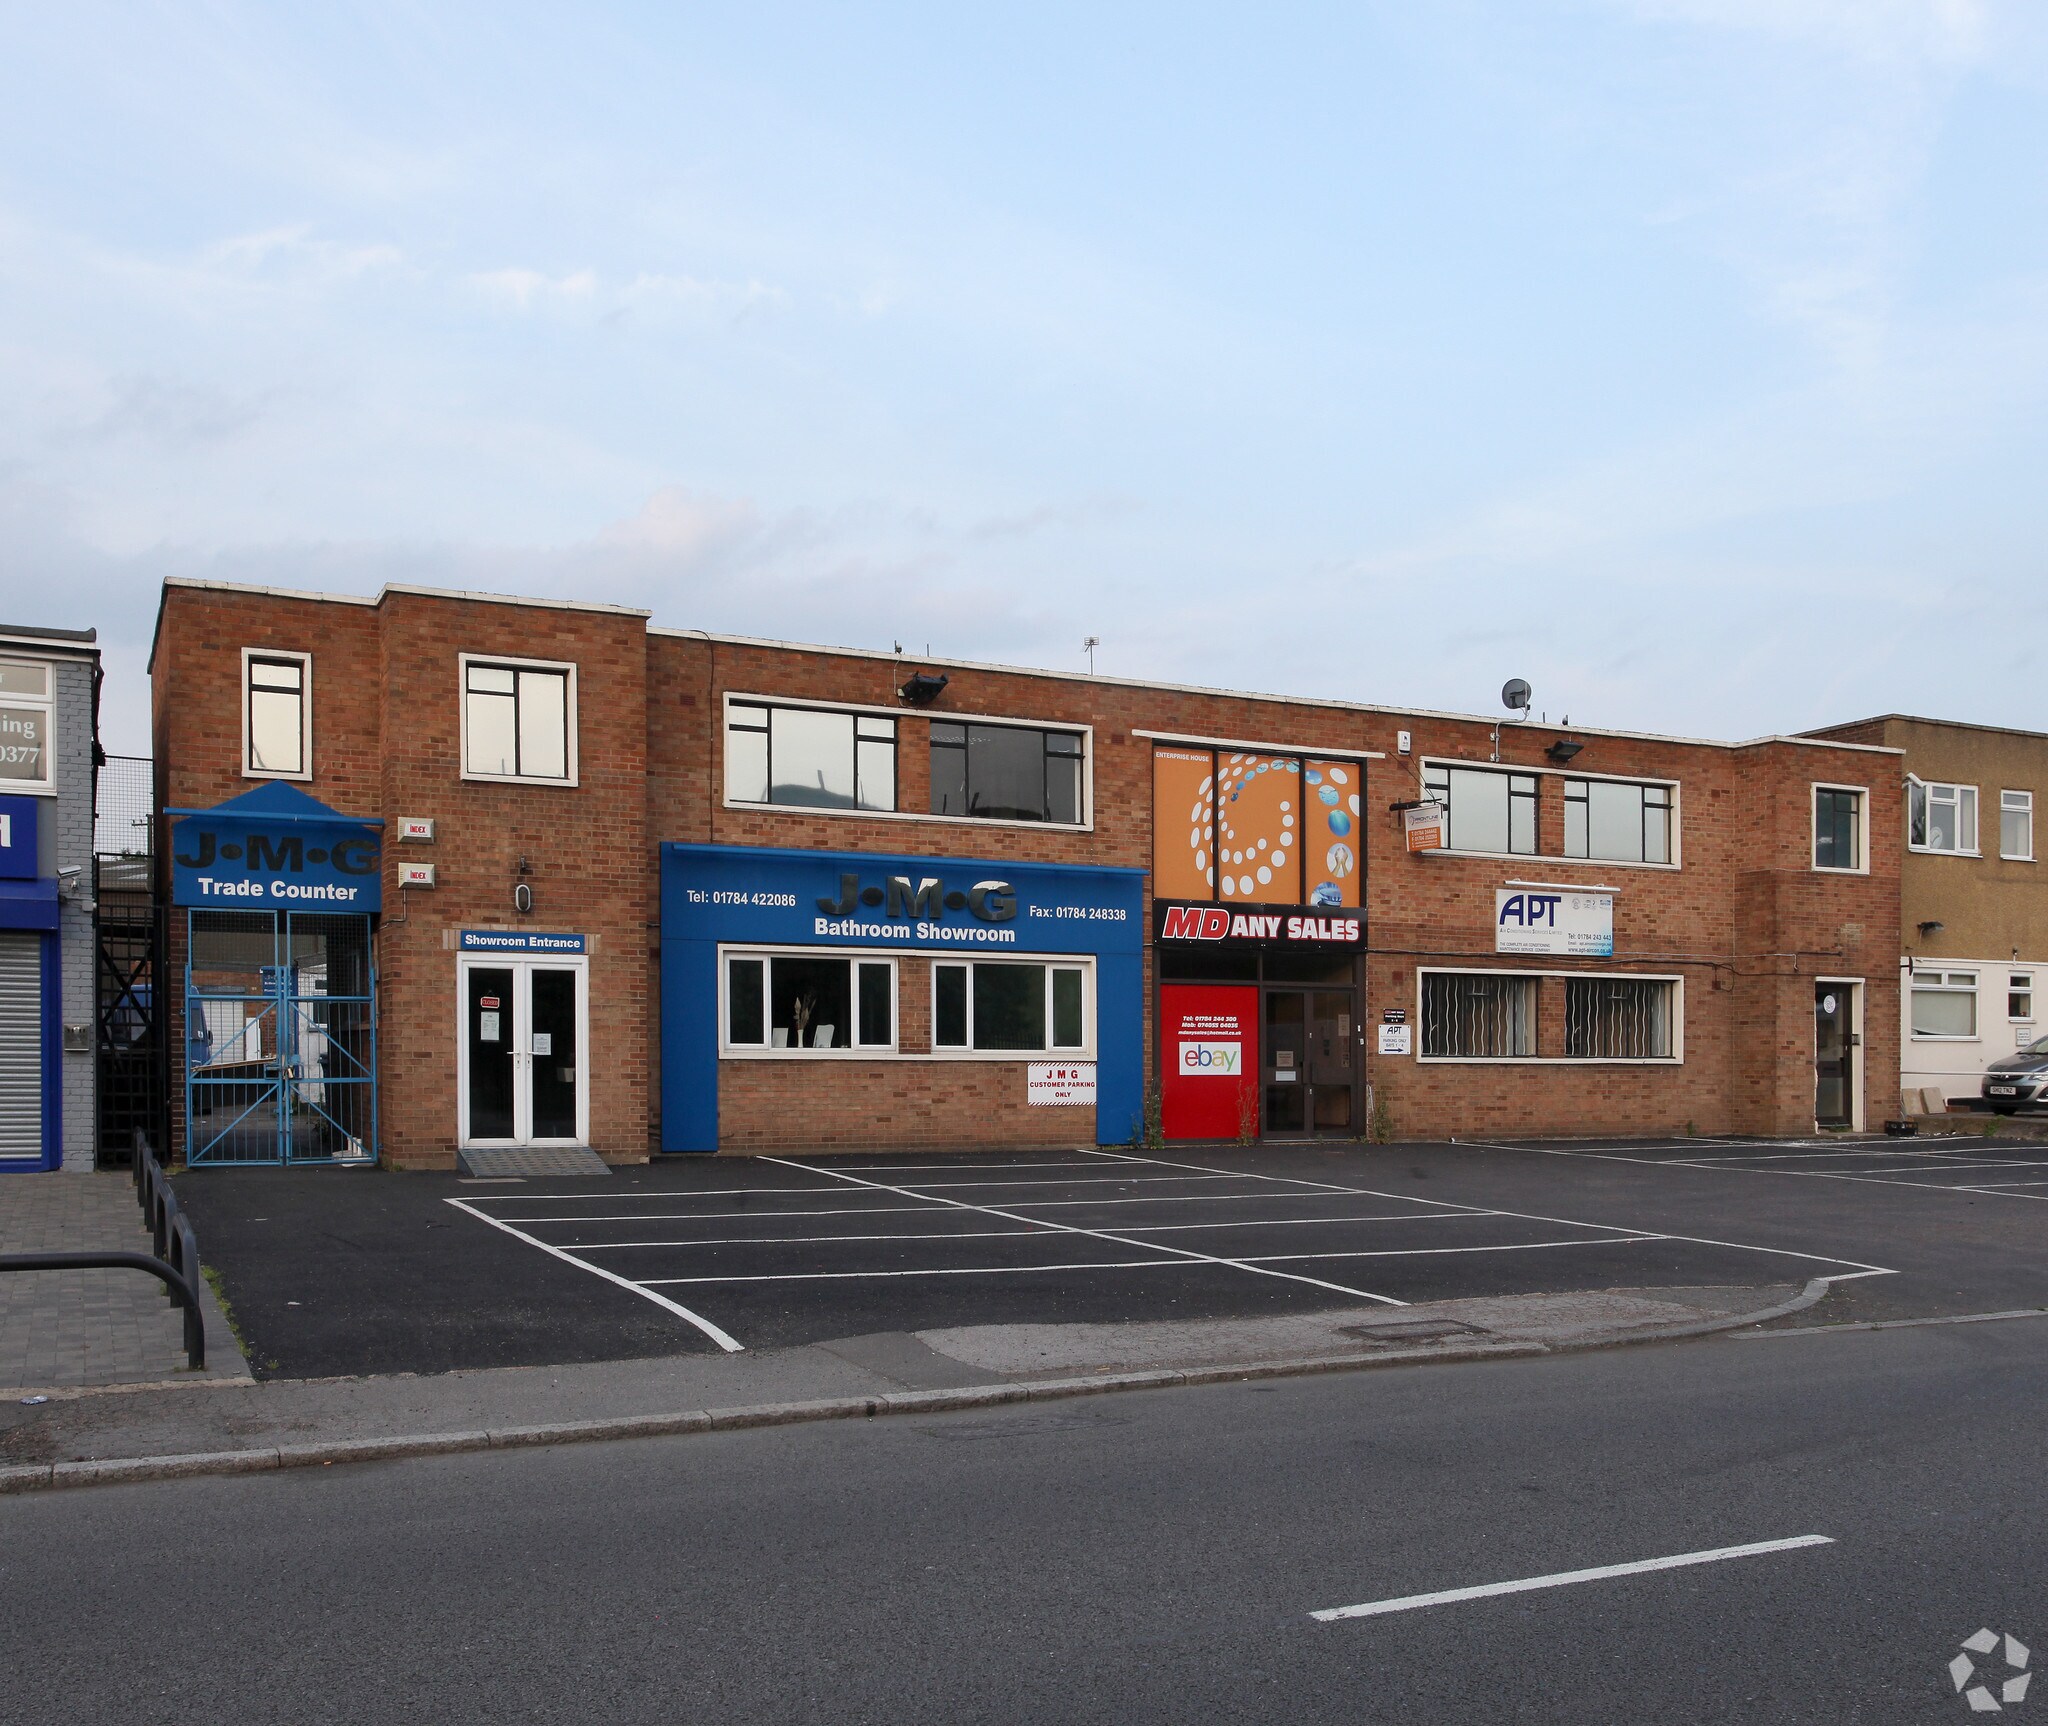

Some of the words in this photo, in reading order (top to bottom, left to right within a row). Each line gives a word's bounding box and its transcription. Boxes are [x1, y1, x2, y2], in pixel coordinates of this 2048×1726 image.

[0, 715, 36, 740] ing
[1156, 751, 1189, 760] ENTERPRISE
[197, 877, 264, 897] Trade
[270, 880, 357, 901] Counter
[686, 890, 709, 903] Tel:
[712, 891, 748, 905] 01784
[751, 892, 796, 907] 422086
[1029, 905, 1053, 918] Fax:
[1056, 906, 1086, 919] 01784
[1089, 907, 1126, 921] 248338
[1499, 894, 1562, 927] APT
[814, 918, 910, 938] Bathroom
[916, 922, 1015, 942] Showroom
[1162, 906, 1231, 940] MD
[1230, 914, 1282, 938] ANY
[1287, 917, 1359, 941] SALES
[465, 934, 526, 947] Showroom
[529, 936, 581, 948] Entrance
[1387, 1026, 1402, 1034] APT
[1184, 1044, 1238, 1072] ebay
